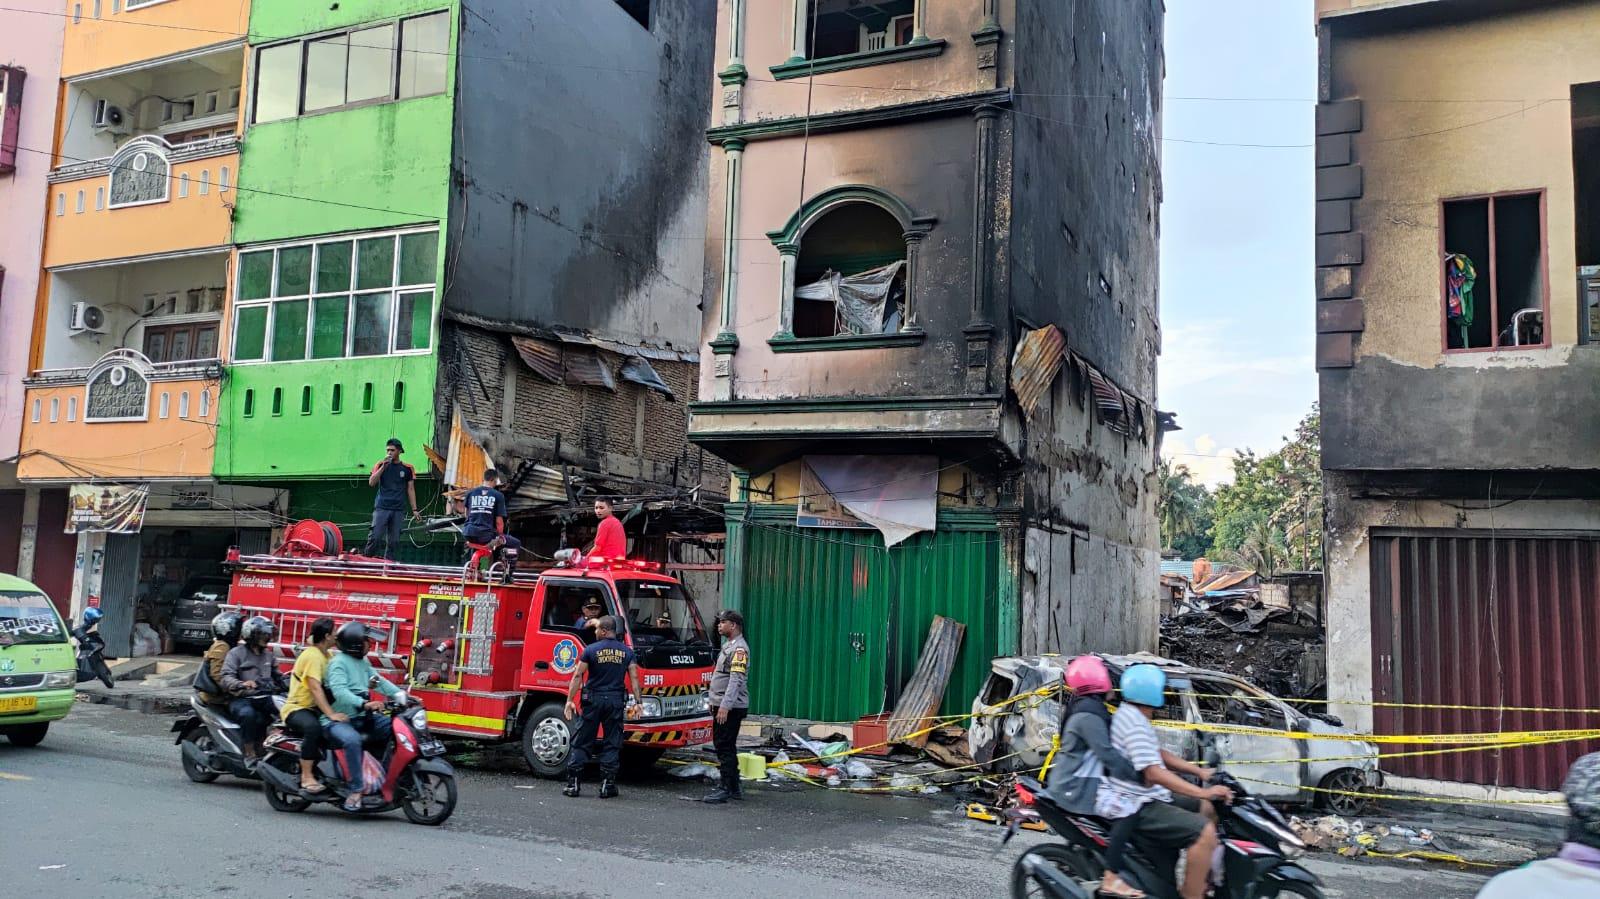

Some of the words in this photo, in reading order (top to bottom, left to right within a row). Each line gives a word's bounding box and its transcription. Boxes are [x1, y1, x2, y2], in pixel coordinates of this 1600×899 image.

[472, 496, 495, 506] NFSC
[346, 600, 396, 612] FIRE
[670, 656, 694, 664] ISUZU
